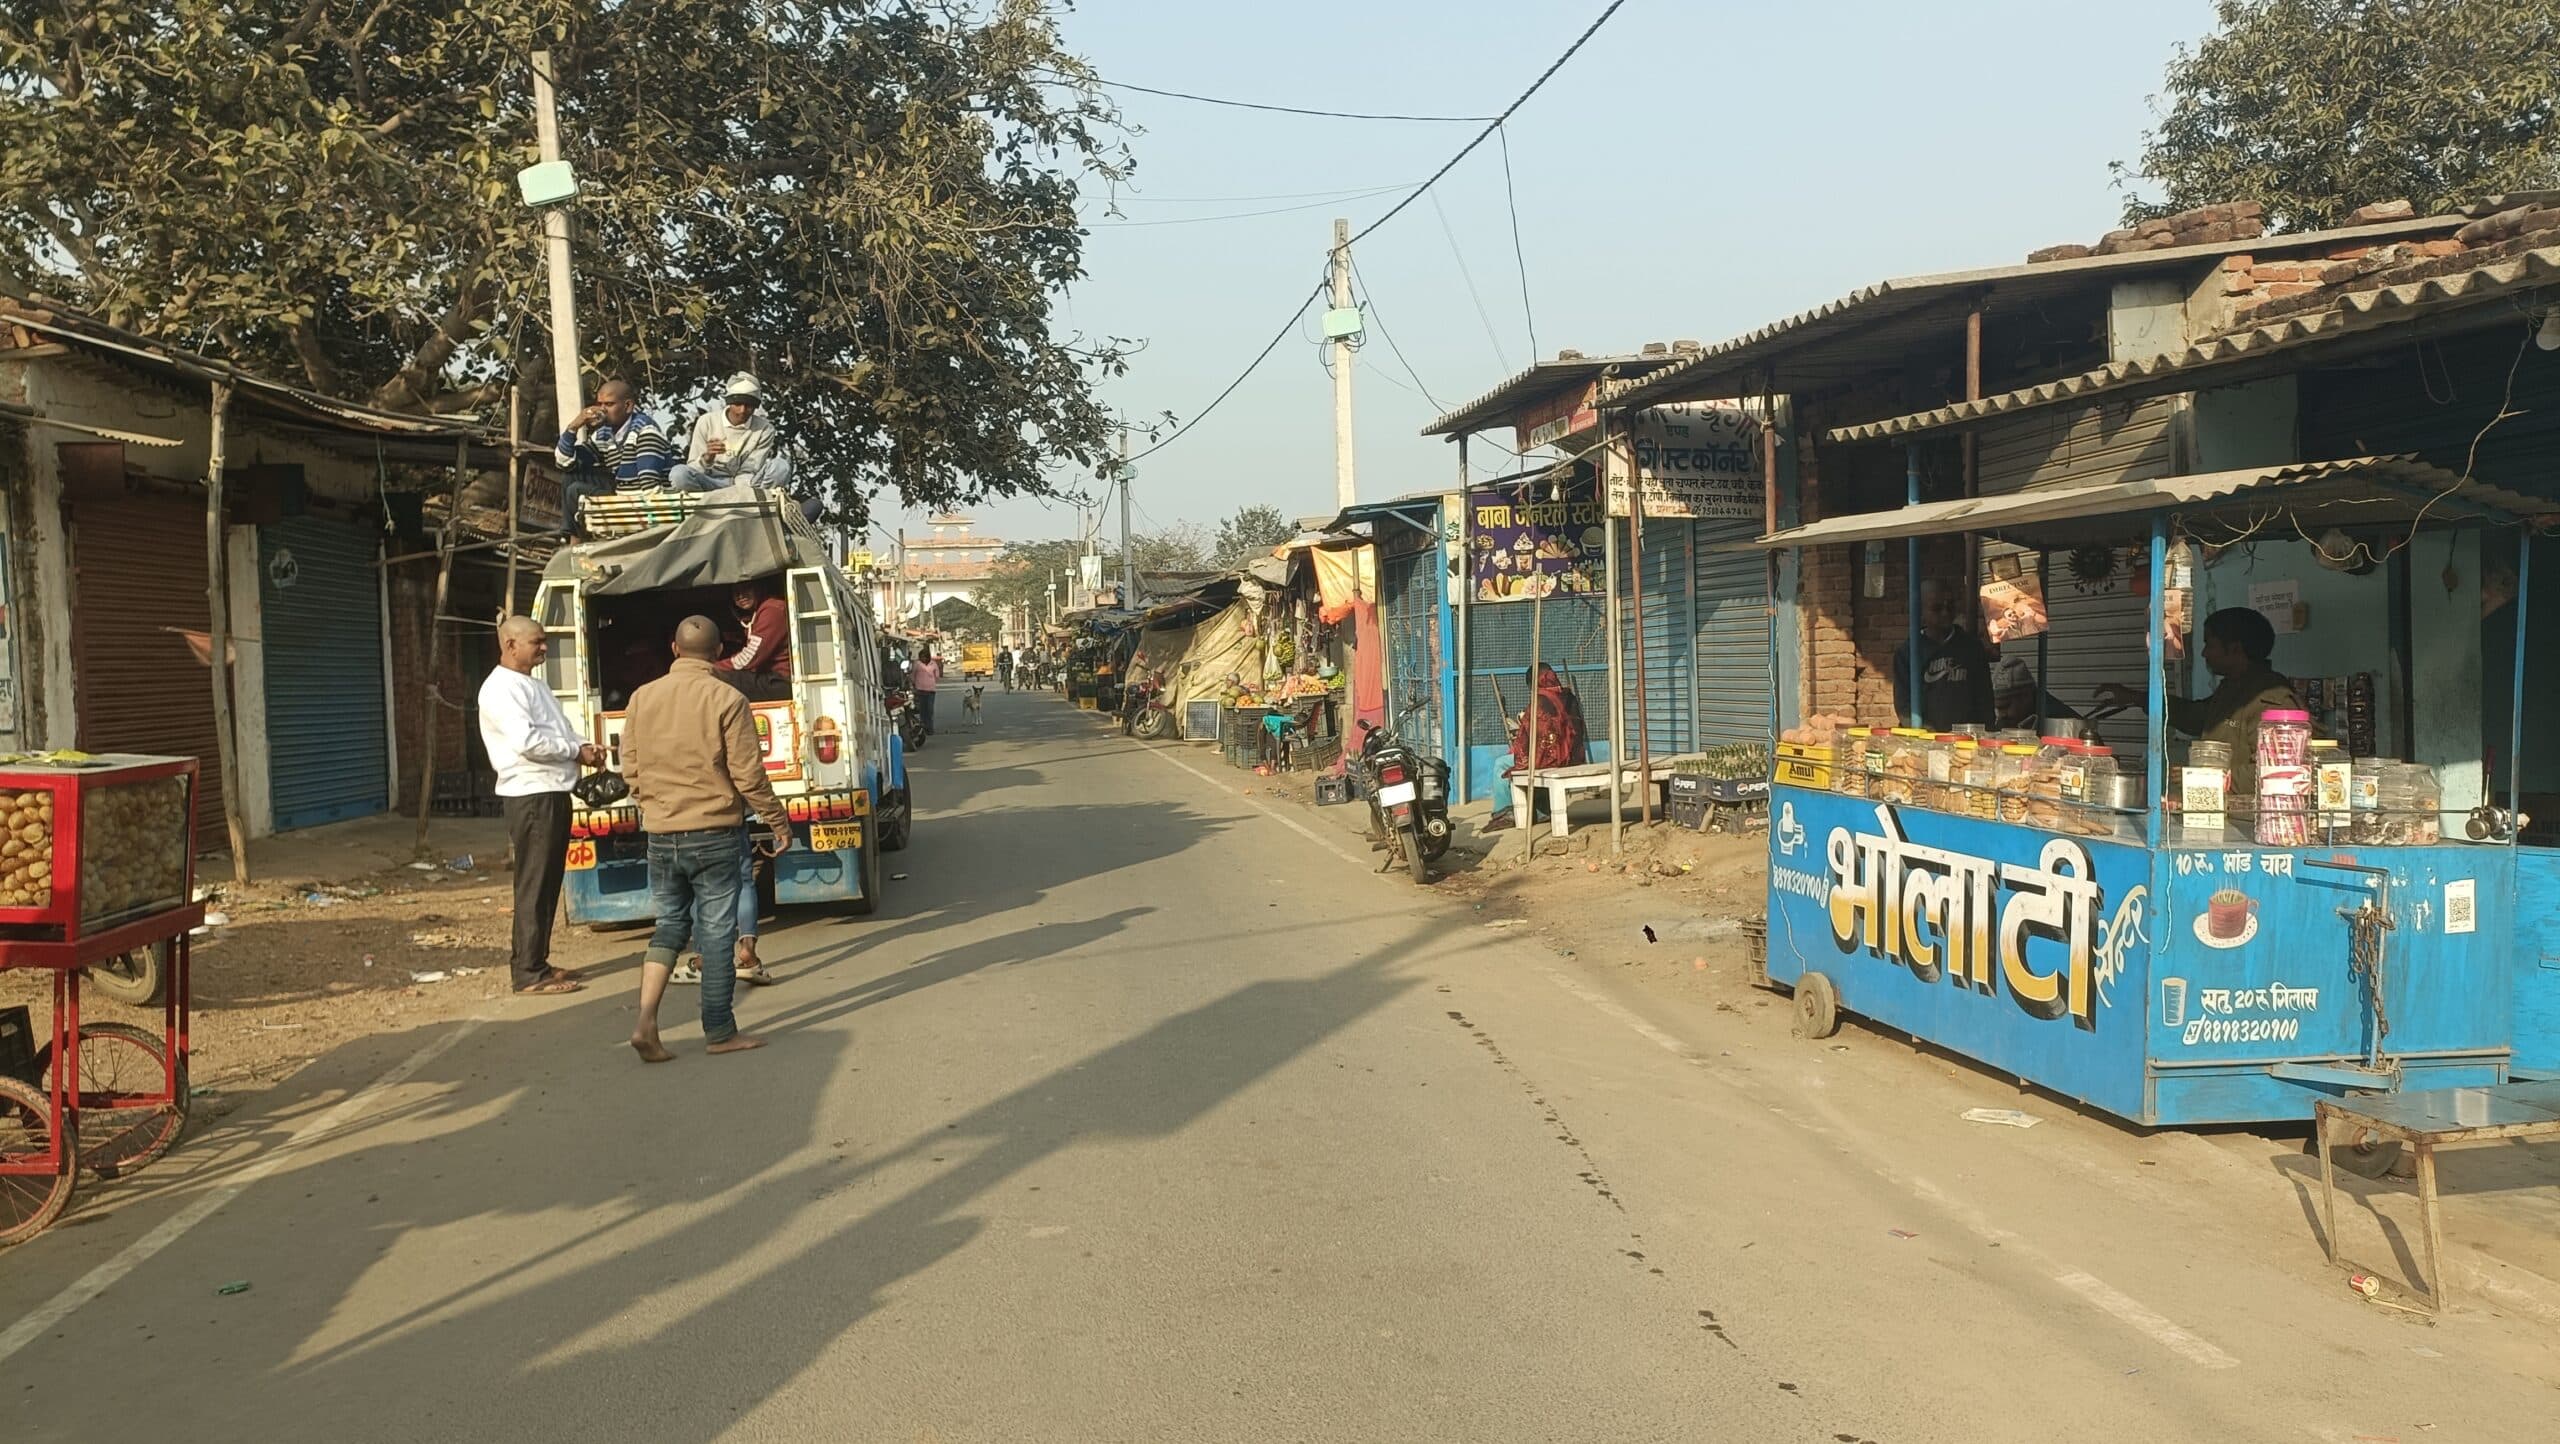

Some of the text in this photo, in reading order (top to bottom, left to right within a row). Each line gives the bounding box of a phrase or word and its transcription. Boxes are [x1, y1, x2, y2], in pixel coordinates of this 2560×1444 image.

[1476, 505, 1511, 529] बाबा
[1789, 762, 1814, 778] Amul
[779, 793, 853, 822] ORN
[2260, 853, 2294, 880] चाय
[1827, 804, 1998, 990] भोला
[2000, 838, 2100, 1022] टी
[2270, 982, 2320, 1013] गिलास
[2203, 1018, 2299, 1045] 8898320900
